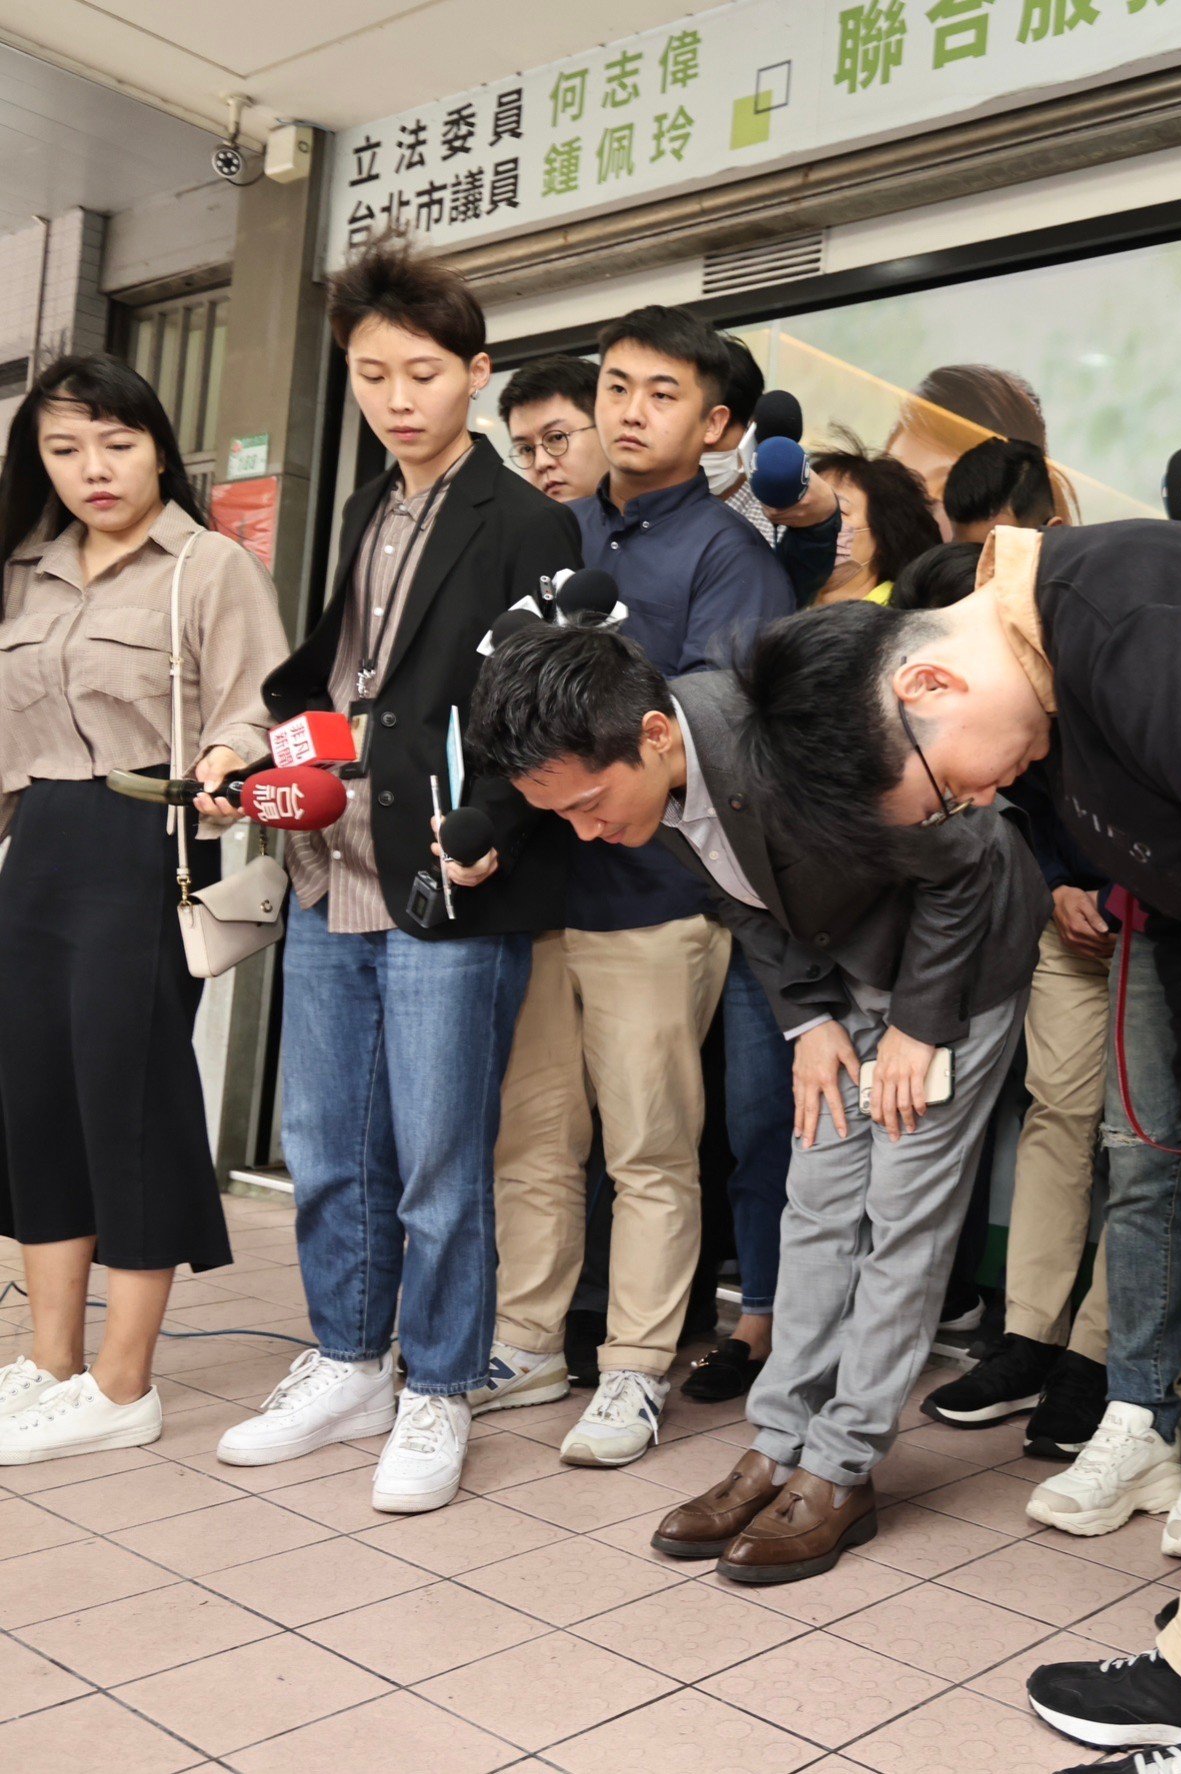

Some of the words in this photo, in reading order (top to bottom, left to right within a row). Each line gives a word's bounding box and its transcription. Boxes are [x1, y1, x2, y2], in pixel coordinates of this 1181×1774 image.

[834, 0, 1166, 94] 聯合
[349, 88, 523, 187] 立法委員
[549, 30, 701, 127] 何志偉
[347, 157, 519, 249] 台北市議員
[253, 783, 305, 822] 台視
